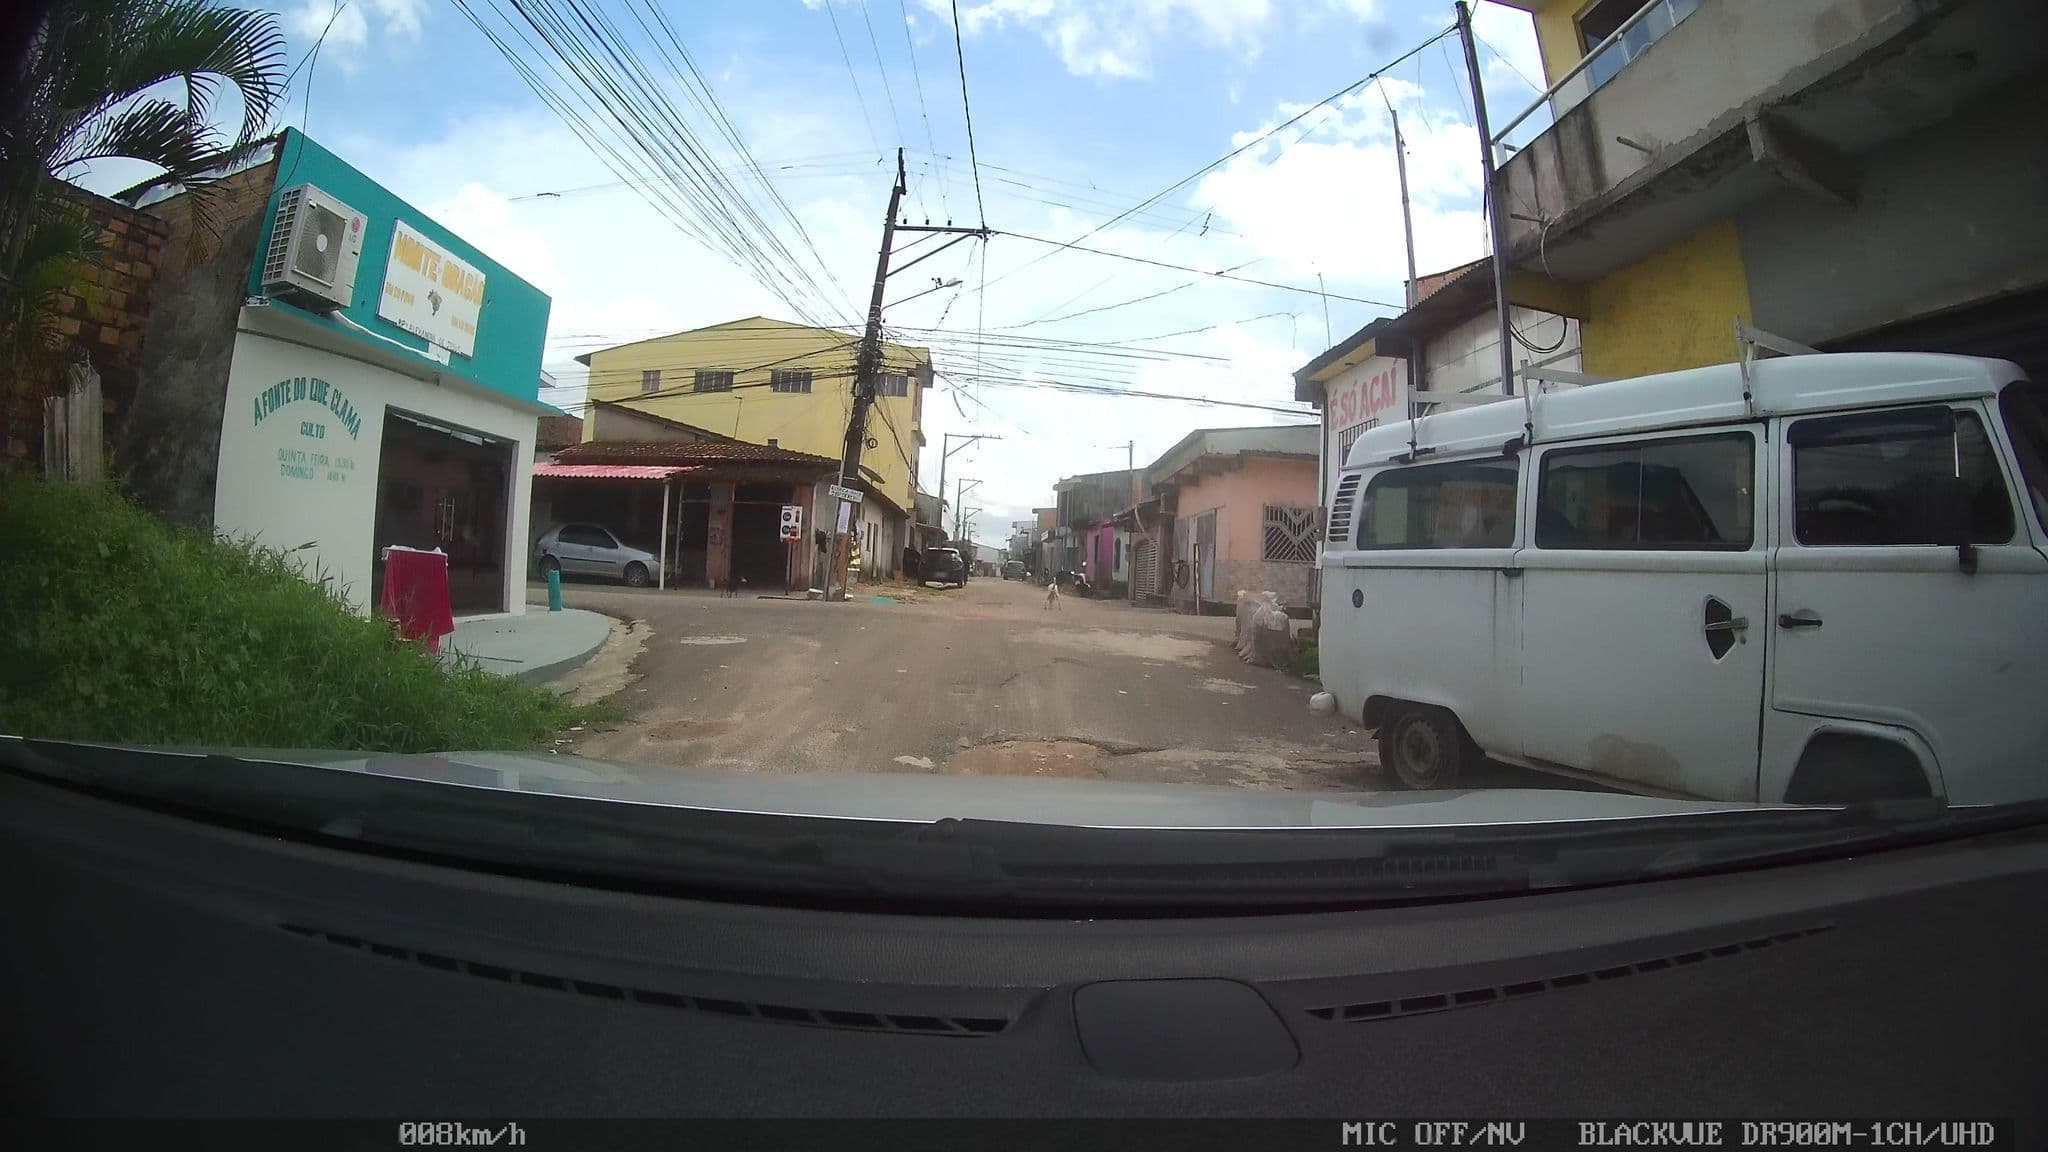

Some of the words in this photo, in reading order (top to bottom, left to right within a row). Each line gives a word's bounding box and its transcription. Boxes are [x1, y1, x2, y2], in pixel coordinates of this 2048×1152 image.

[254, 396, 263, 427] A
[262, 379, 291, 418] FONTE
[293, 377, 306, 401] DO
[310, 377, 330, 406] QUE
[330, 388, 361, 441] CLAMA
[300, 421, 326, 439] CULTO
[279, 463, 315, 480] DOMINGO
